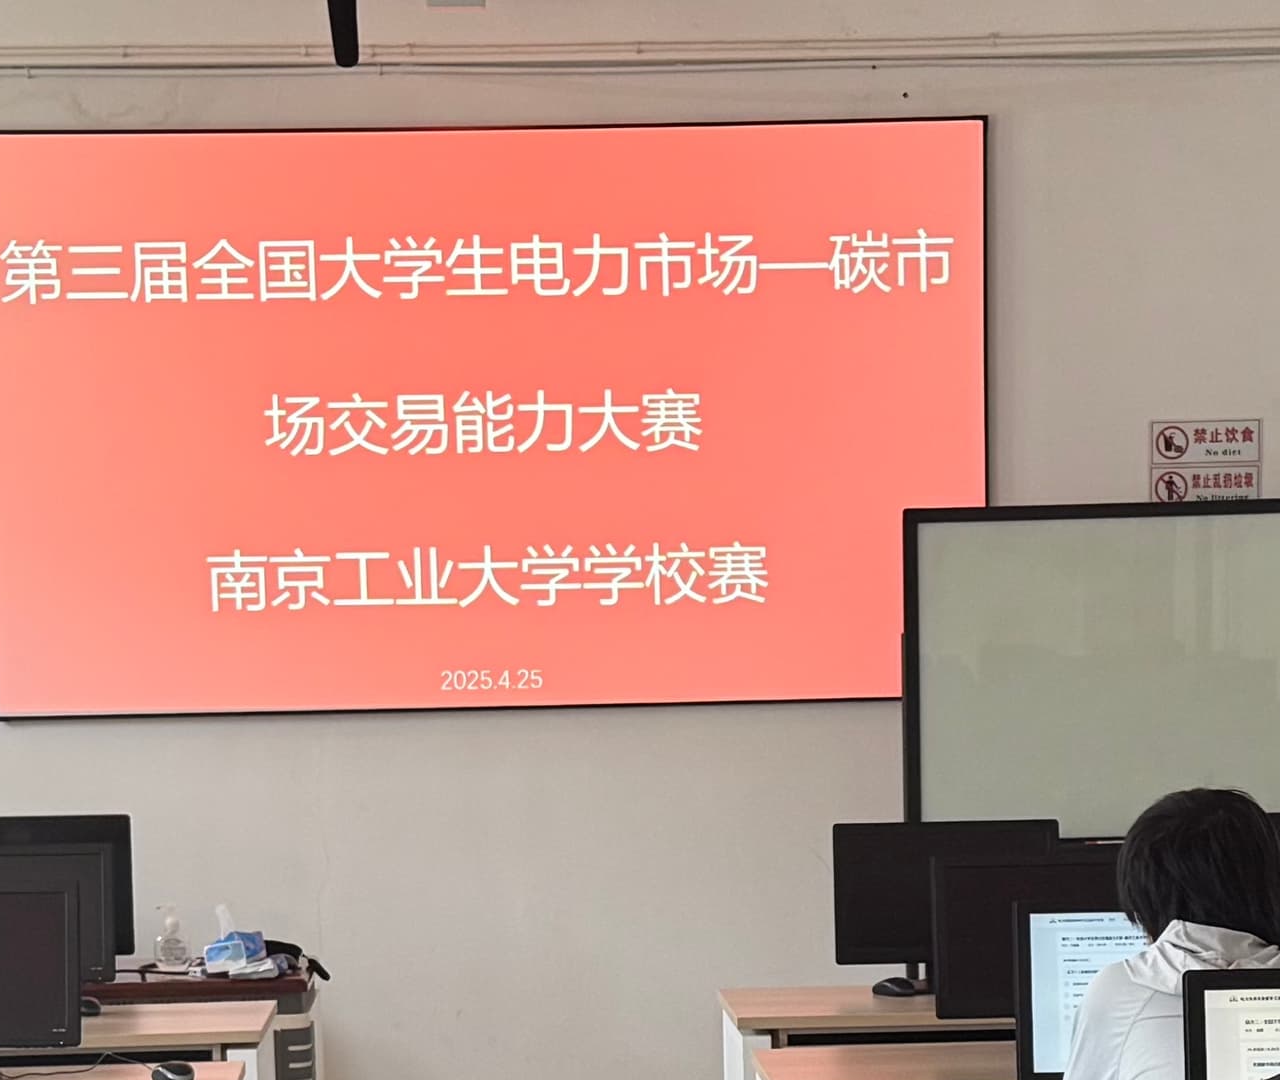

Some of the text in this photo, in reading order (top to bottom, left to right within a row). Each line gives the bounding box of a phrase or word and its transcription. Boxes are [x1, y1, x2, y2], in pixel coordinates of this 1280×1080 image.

[263, 387, 704, 457] 场交易能力大赛
[1193, 426, 1255, 444] 禁止饮食
[1205, 448, 1219, 456] No
[1192, 472, 1254, 489] 禁止乱扔垃圾
[206, 541, 770, 613] 南京工业大学学校赛
[440, 668, 543, 690] 2025.4.25
